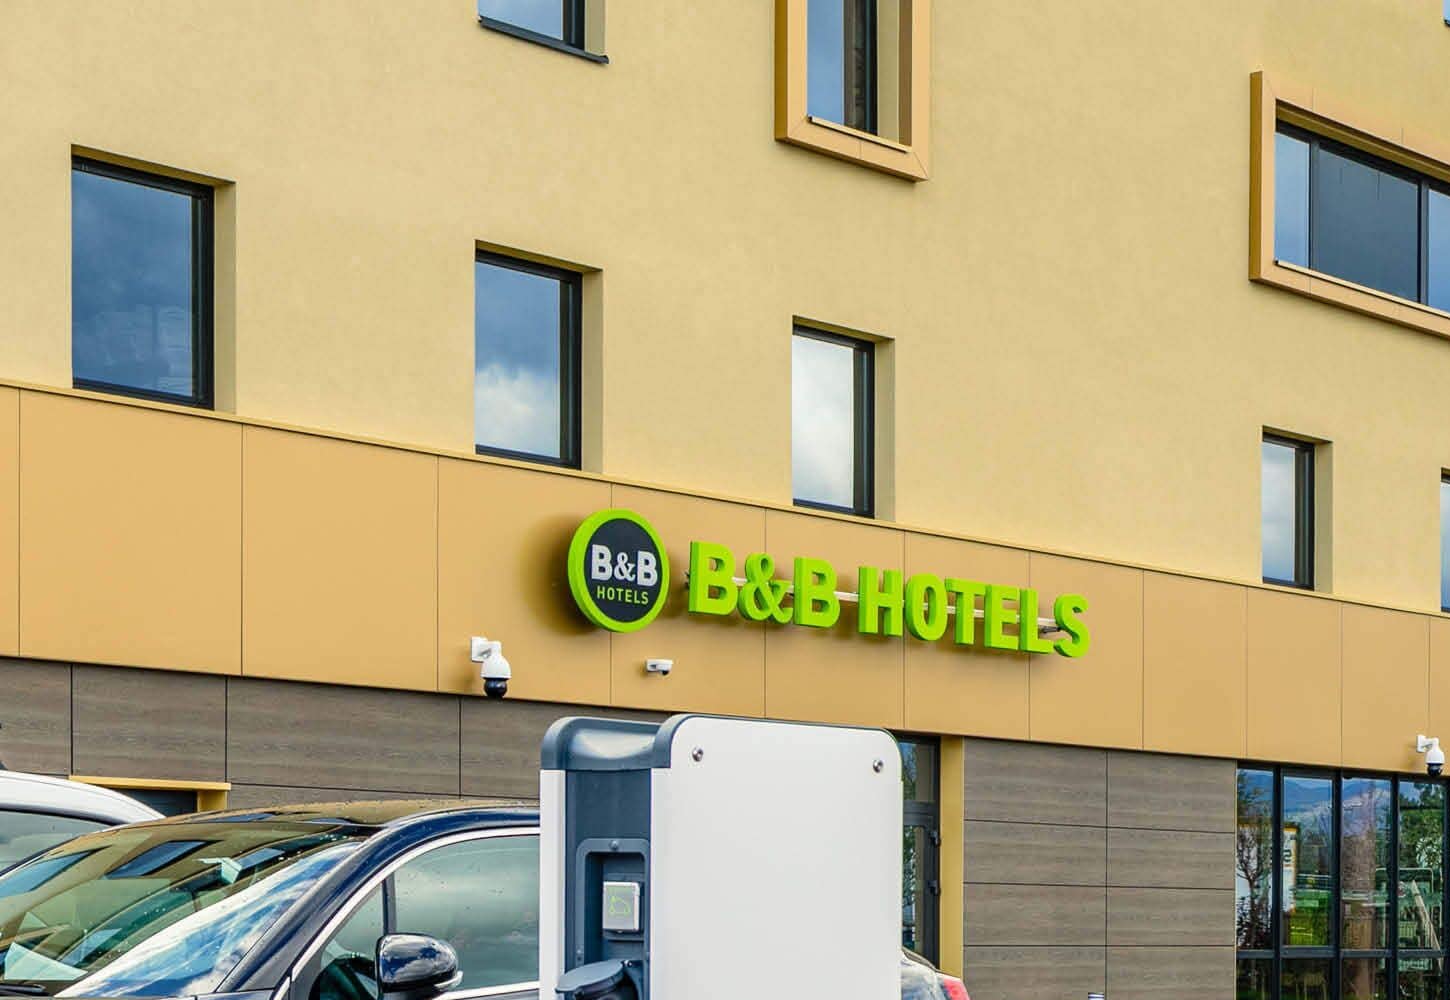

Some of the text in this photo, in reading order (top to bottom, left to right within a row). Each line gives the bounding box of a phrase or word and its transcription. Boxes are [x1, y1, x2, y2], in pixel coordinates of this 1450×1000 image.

[591, 544, 658, 587] B&B
[596, 585, 649, 605] HOTELS
[688, 541, 1090, 658] B&B HOTELS
